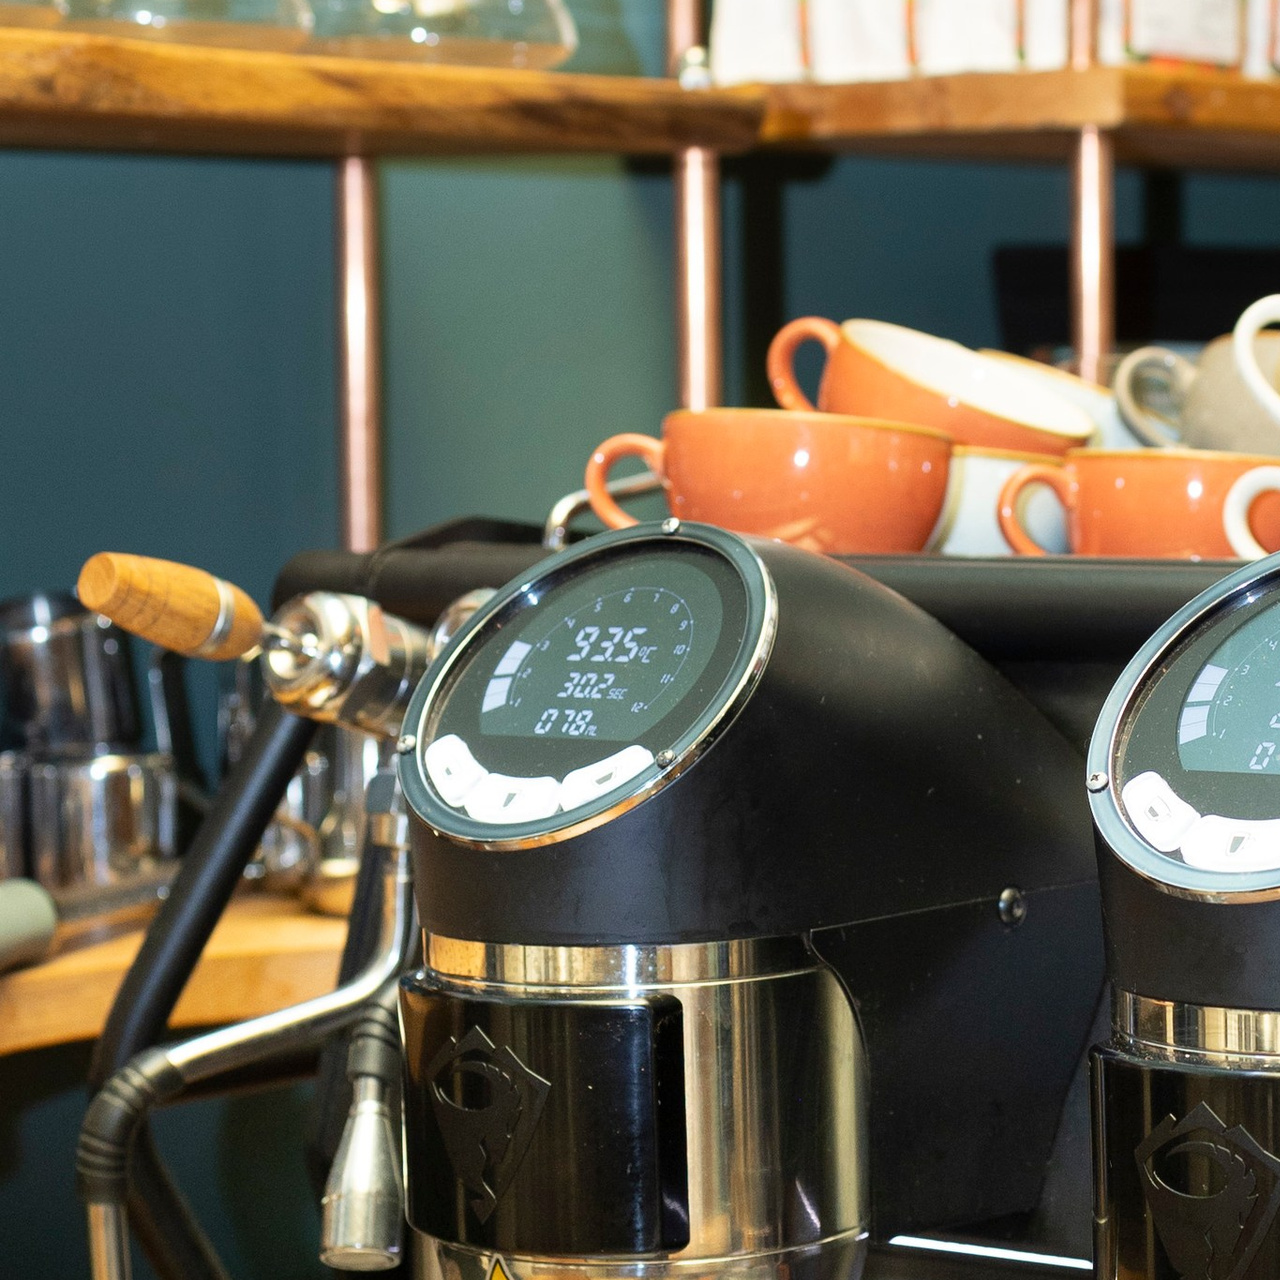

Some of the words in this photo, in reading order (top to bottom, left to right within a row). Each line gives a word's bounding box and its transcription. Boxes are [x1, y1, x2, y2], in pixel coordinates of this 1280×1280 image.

[623, 593, 633, 603] 6
[653, 592, 660, 602] 7
[594, 602, 603, 613] 5
[669, 603, 679, 614] 8
[567, 619, 575, 629] 4
[679, 620, 688, 631] 9
[540, 640, 550, 651] 3
[566, 626, 648, 663] 93.5
[673, 644, 686, 655] 10
[522, 668, 532, 678] 2
[660, 674, 670, 684] 11
[556, 672, 615, 699] 30.2
[606, 688, 628, 699] SEC
[1219, 729, 1226, 739] 1
[1223, 696, 1233, 706] 2
[1241, 664, 1250, 675] 3
[1269, 640, 1278, 651] 4
[514, 697, 522, 708] 1
[631, 702, 644, 713] 12
[534, 708, 593, 736] 078
